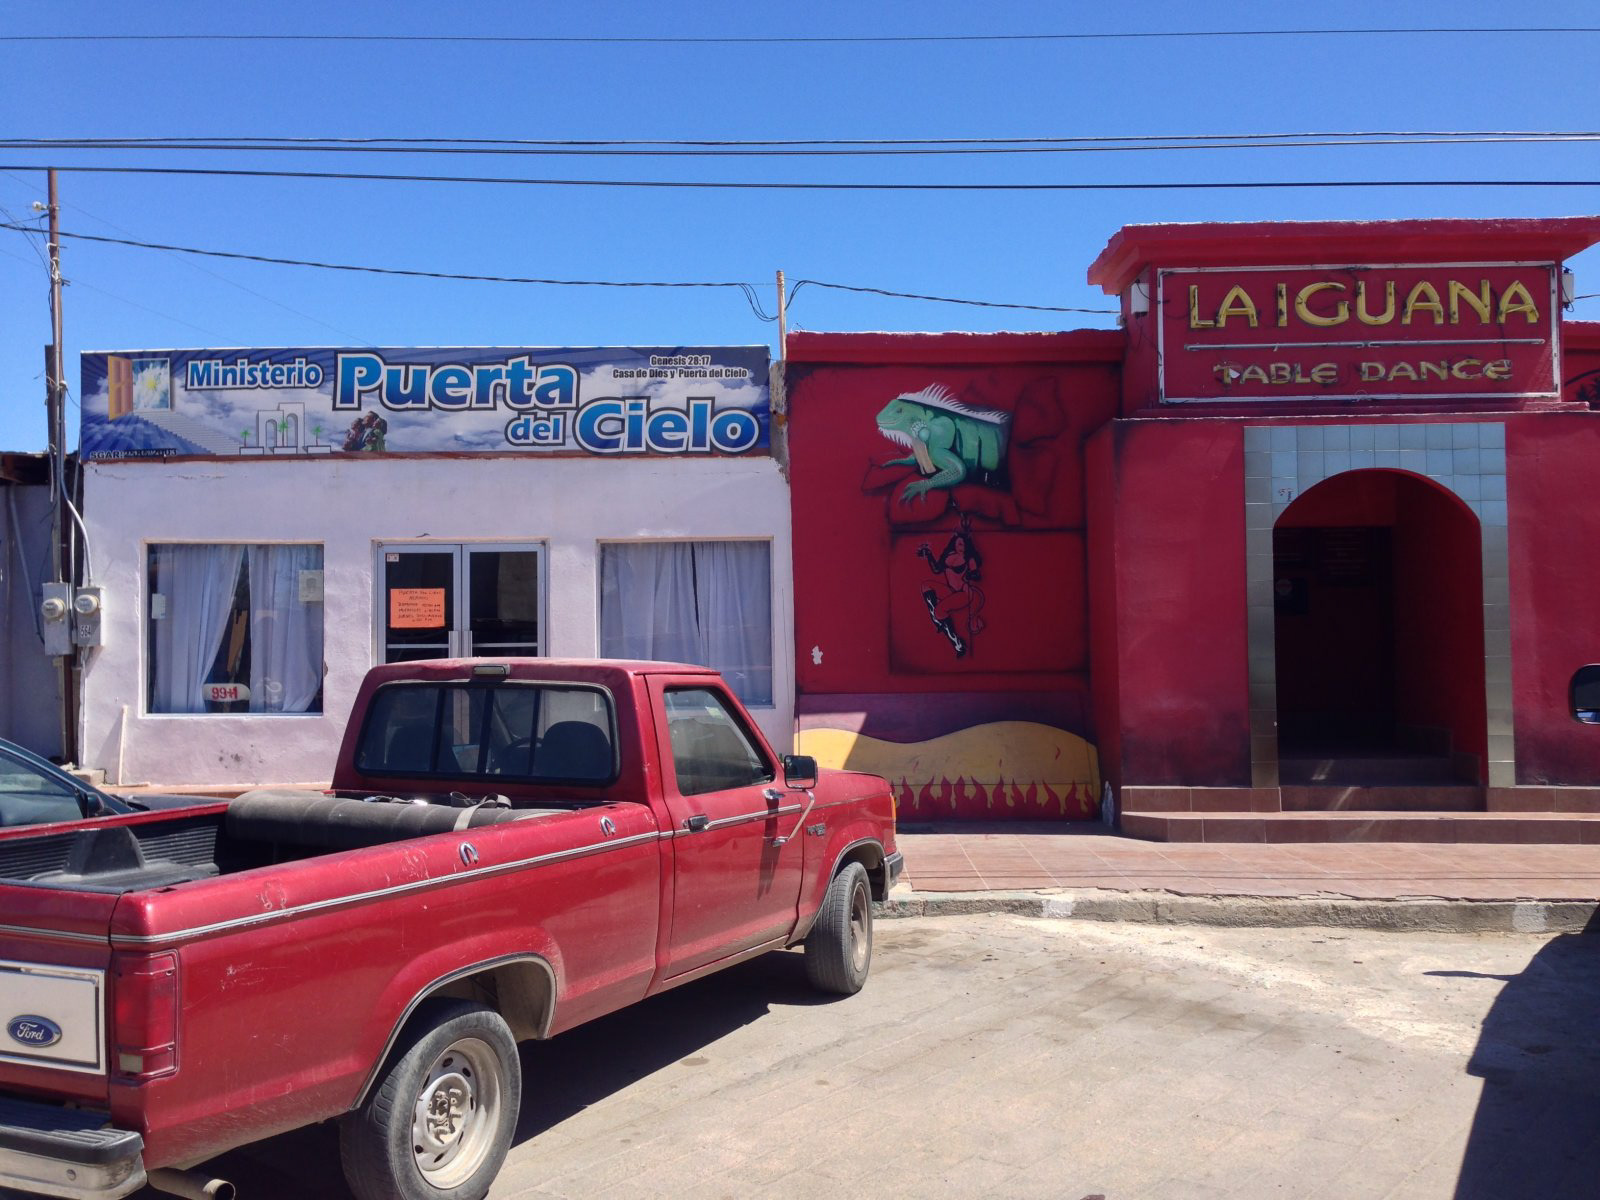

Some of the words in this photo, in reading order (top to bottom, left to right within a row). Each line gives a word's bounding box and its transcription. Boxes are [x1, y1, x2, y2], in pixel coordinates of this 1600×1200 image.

[1189, 283, 1258, 329] LA
[1277, 279, 1540, 327] IGUANA
[187, 357, 323, 389] Ministerio
[612, 368, 635, 379] Casa
[636, 368, 648, 379] de
[649, 368, 669, 379] Dios
[678, 368, 707, 379] Puerta
[709, 368, 723, 379] del
[724, 367, 748, 379] Cielo
[651, 355, 687, 366] Genesis
[688, 355, 711, 366] 28:17
[1213, 360, 1339, 385] TABLE
[1360, 358, 1513, 382] DANCE
[335, 352, 578, 410] Puerta
[507, 412, 564, 445] del
[575, 398, 758, 453] Cielo
[16, 1021, 45, 1041] Ford
